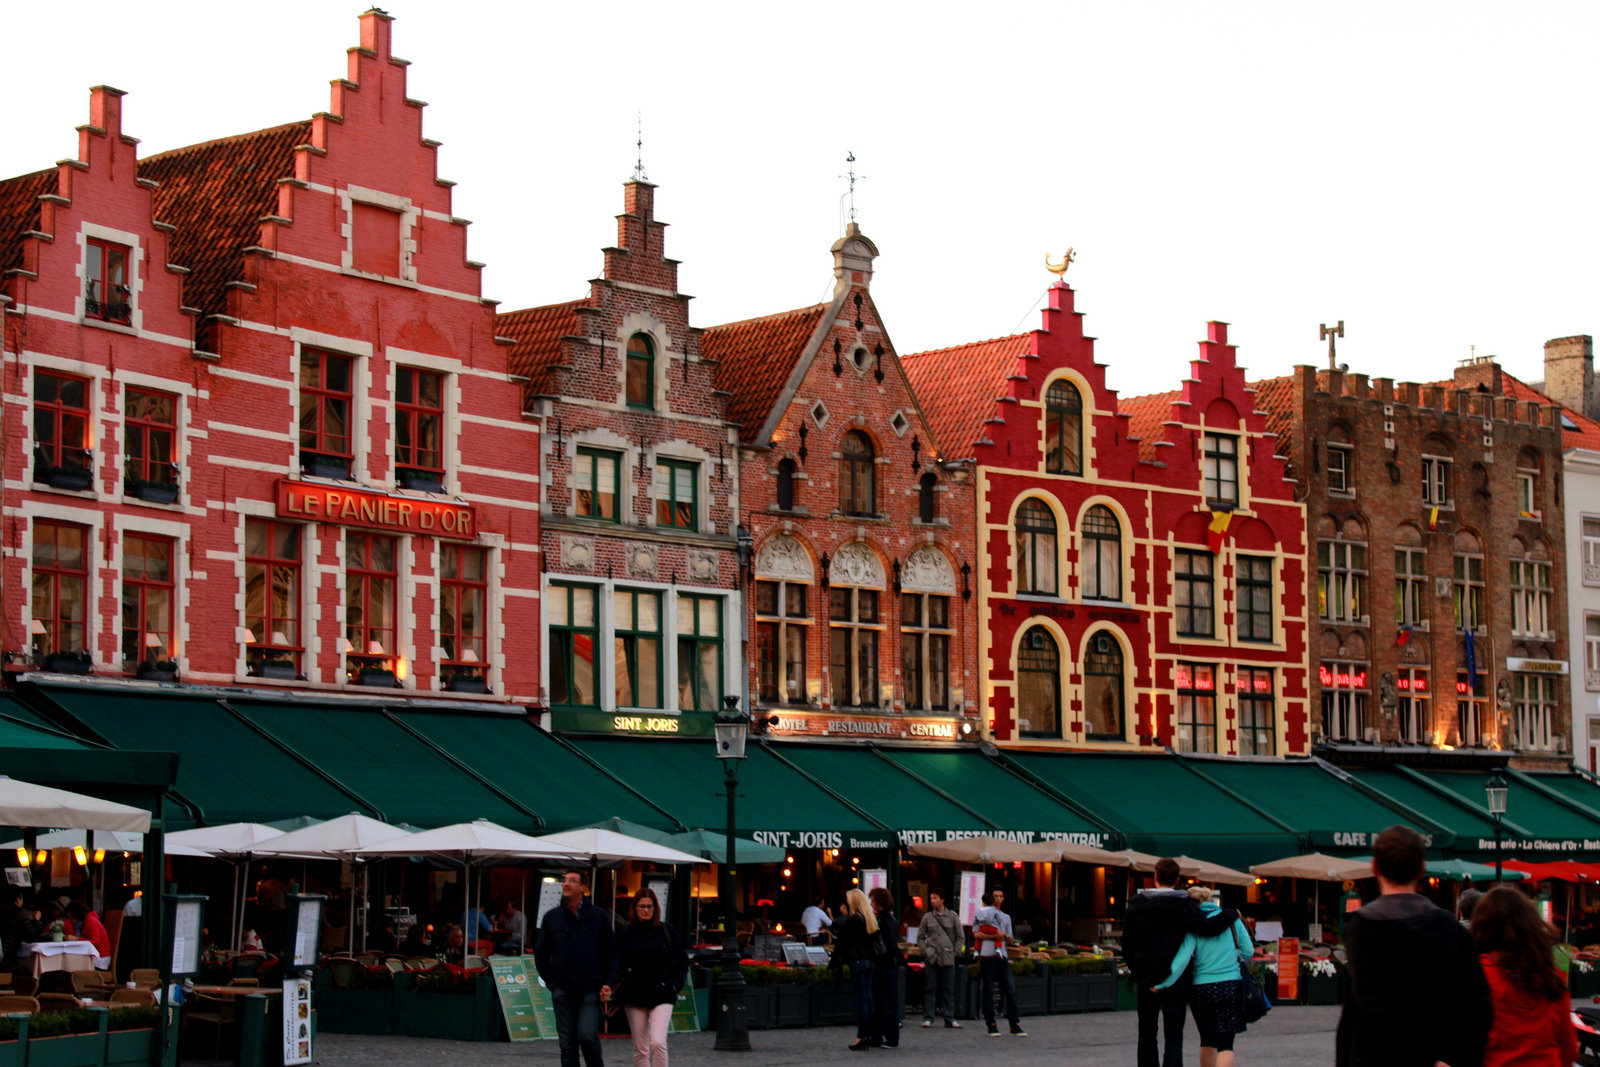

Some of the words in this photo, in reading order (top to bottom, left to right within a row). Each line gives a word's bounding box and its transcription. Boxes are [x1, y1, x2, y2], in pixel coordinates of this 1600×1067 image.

[288, 492, 320, 515] LE
[326, 492, 413, 526] PANIER
[420, 507, 471, 534] D'OR
[614, 716, 642, 731] SINT
[645, 717, 679, 733] JORIS
[828, 720, 892, 735] RESTAURANT
[910, 723, 952, 737] CENTRAL
[753, 830, 842, 848] SINT-JORIS
[850, 838, 889, 848] Brasserie
[897, 830, 937, 847] HOTEL
[1334, 831, 1366, 846] CAFE
[1479, 838, 1517, 849] Braserie
[1523, 840, 1533, 850] La
